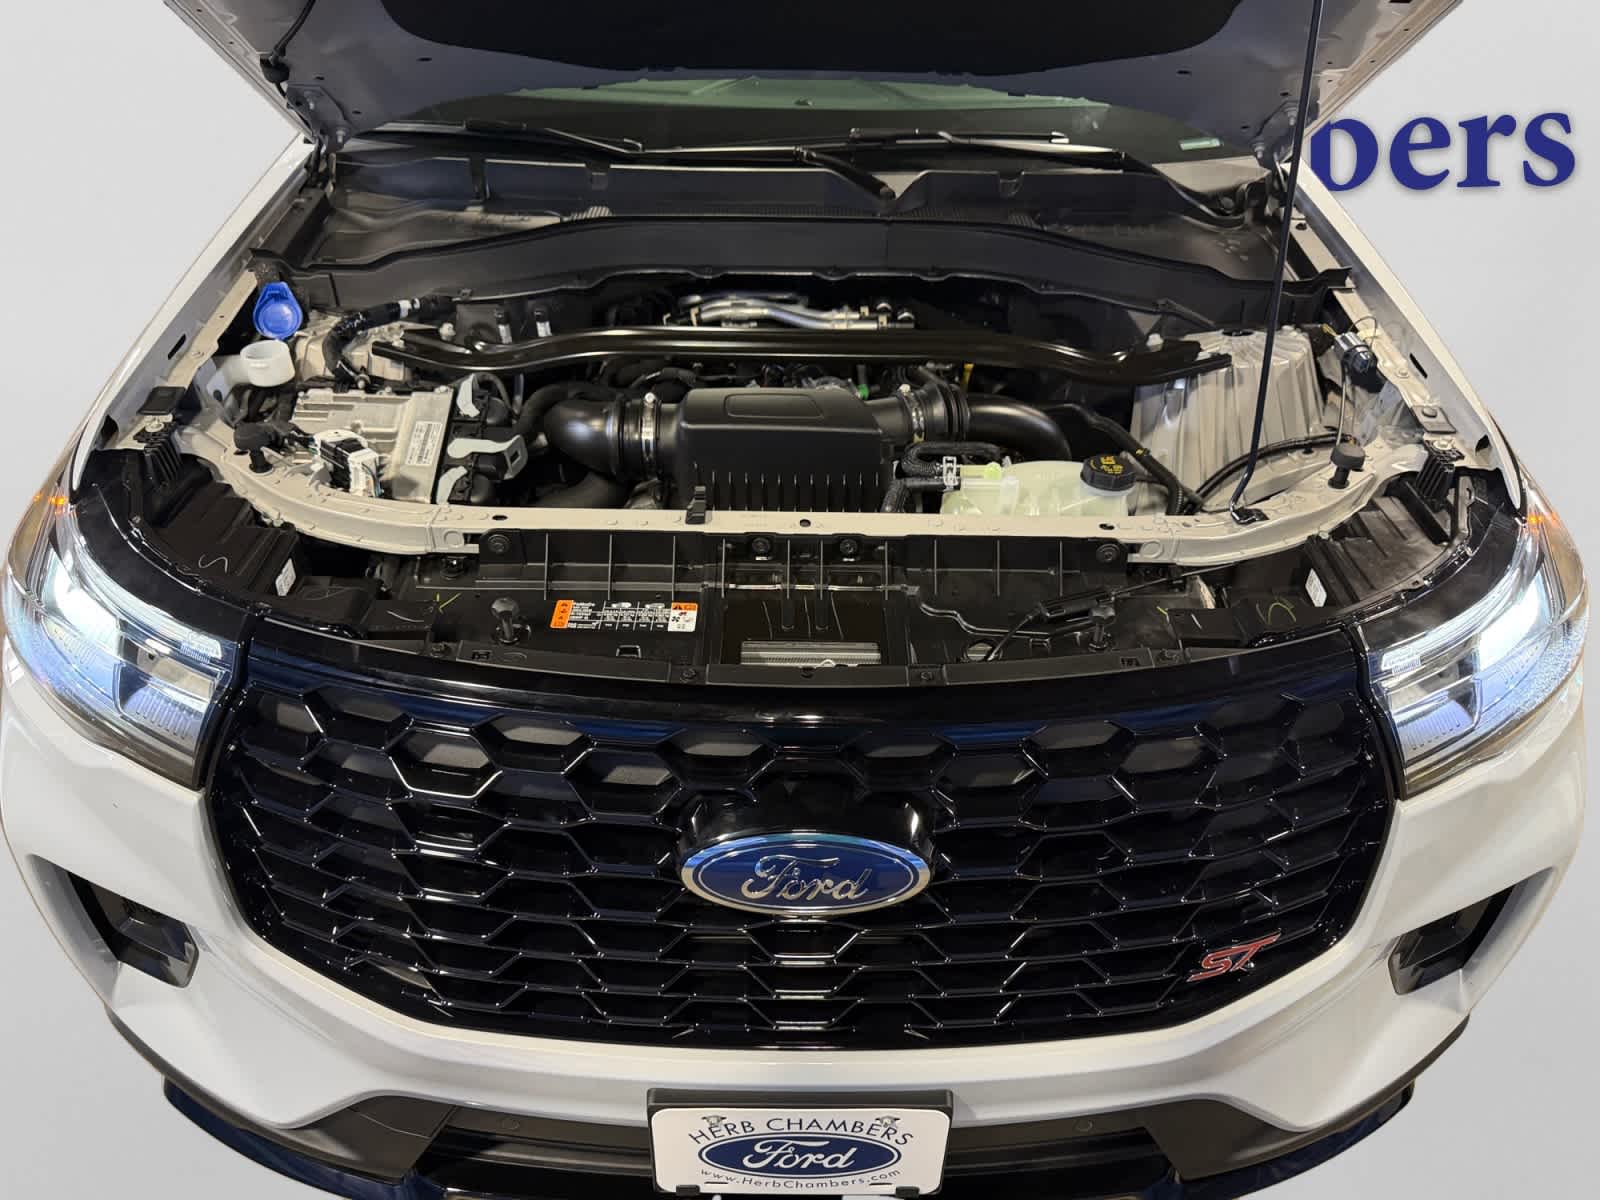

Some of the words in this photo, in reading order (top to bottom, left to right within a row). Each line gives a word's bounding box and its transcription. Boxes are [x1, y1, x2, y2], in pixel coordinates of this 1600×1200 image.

[740, 854, 873, 900] Ford
[1186, 928, 1282, 983] ST
[688, 1119, 755, 1145] HERB
[766, 1117, 915, 1147] CHAMBERS
[741, 1138, 858, 1169] Ford
[700, 1168, 902, 1190] www.HerbChambers.com
